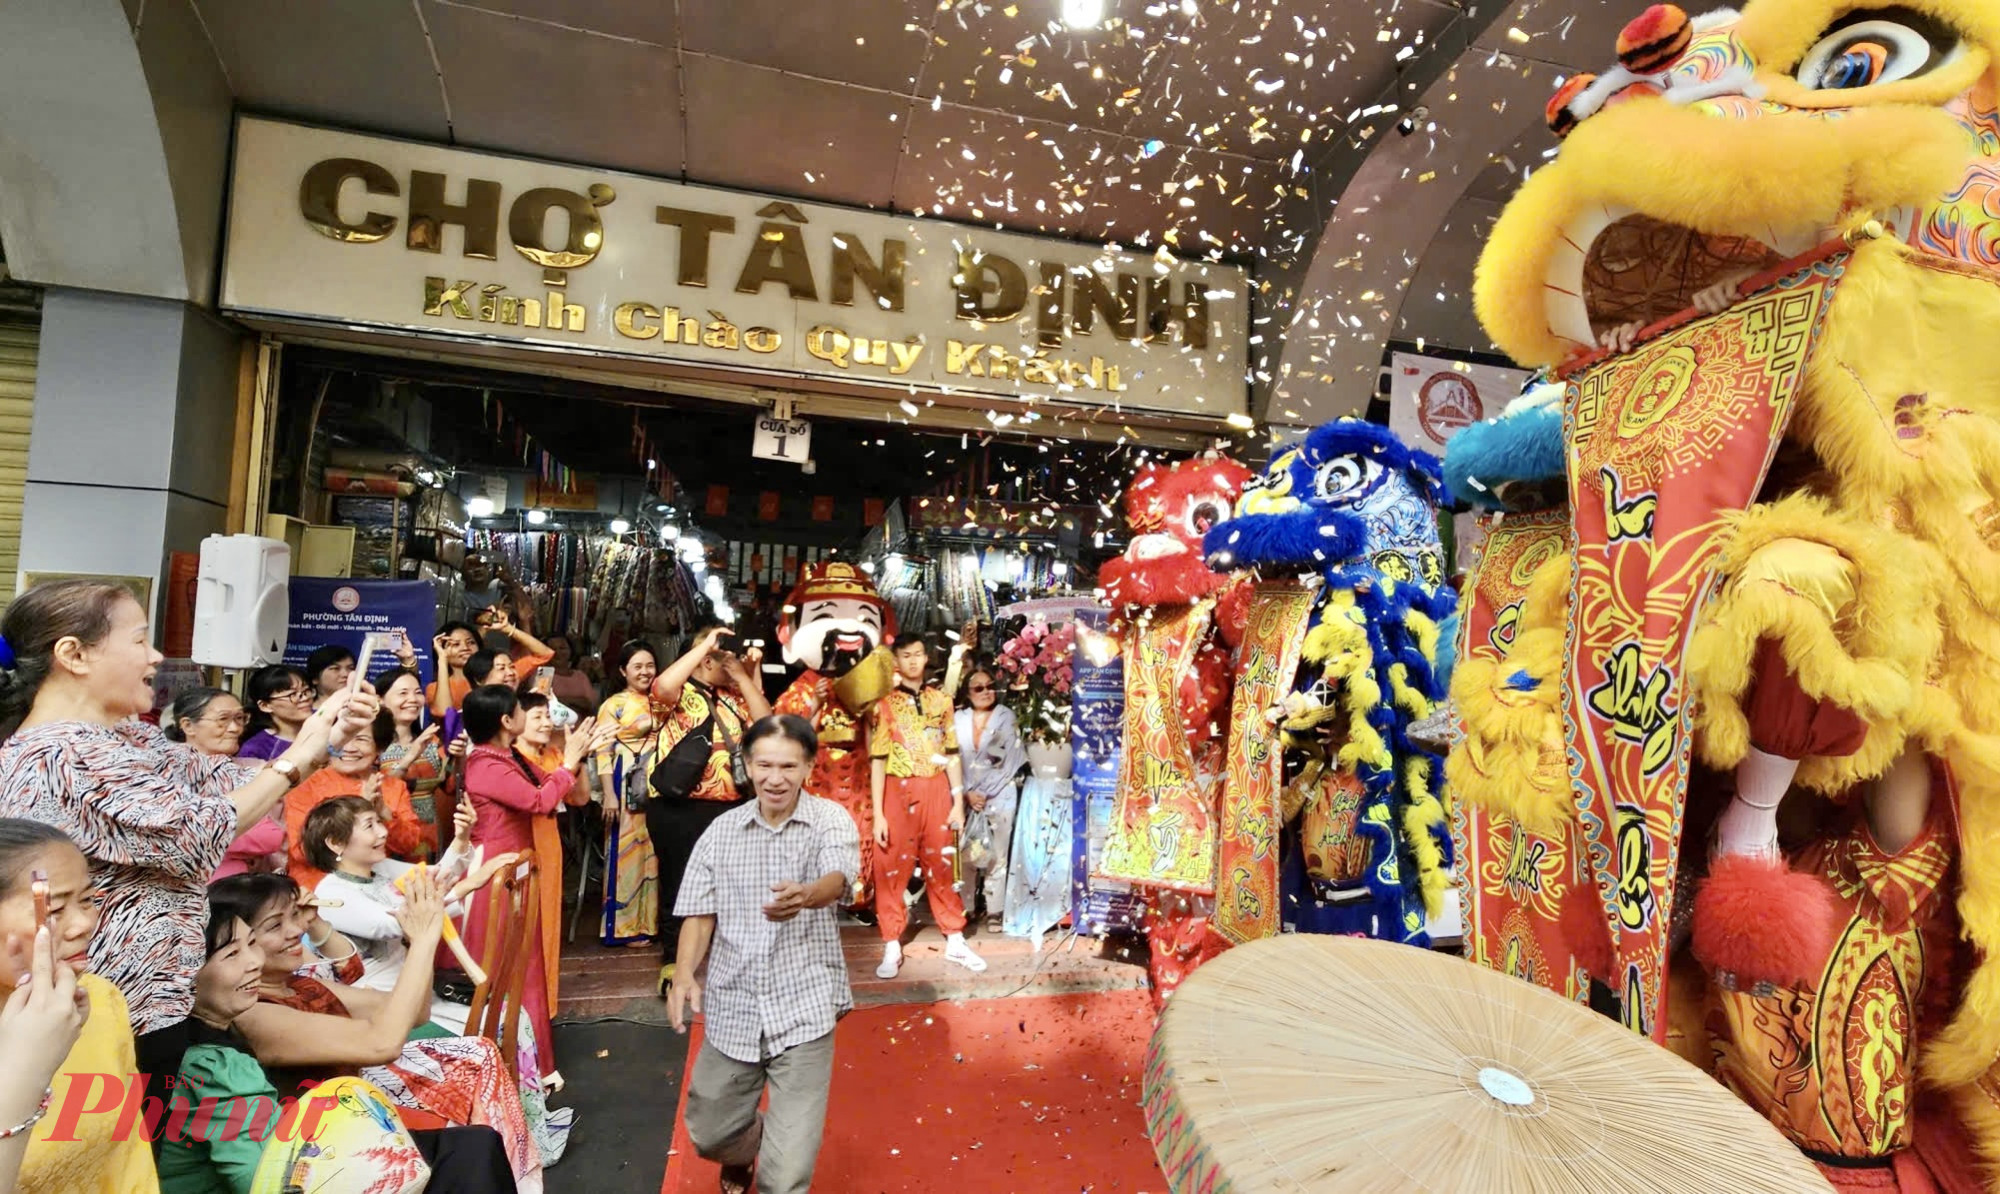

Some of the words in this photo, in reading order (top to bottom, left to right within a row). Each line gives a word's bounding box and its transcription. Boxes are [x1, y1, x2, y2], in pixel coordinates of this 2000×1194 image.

[299, 157, 616, 287] CHỢ
[655, 201, 906, 313] TÂN
[953, 248, 1209, 350] ĐỊNH
[423, 276, 588, 333] Kính
[614, 301, 783, 353] Chào
[806, 325, 924, 374] Quý
[946, 340, 1121, 392] Khách
[771, 435, 790, 458] 1
[303, 613, 343, 622] PHƯỜNG
[344, 613, 362, 622] TÂN
[364, 615, 389, 624] ĐỊNH
